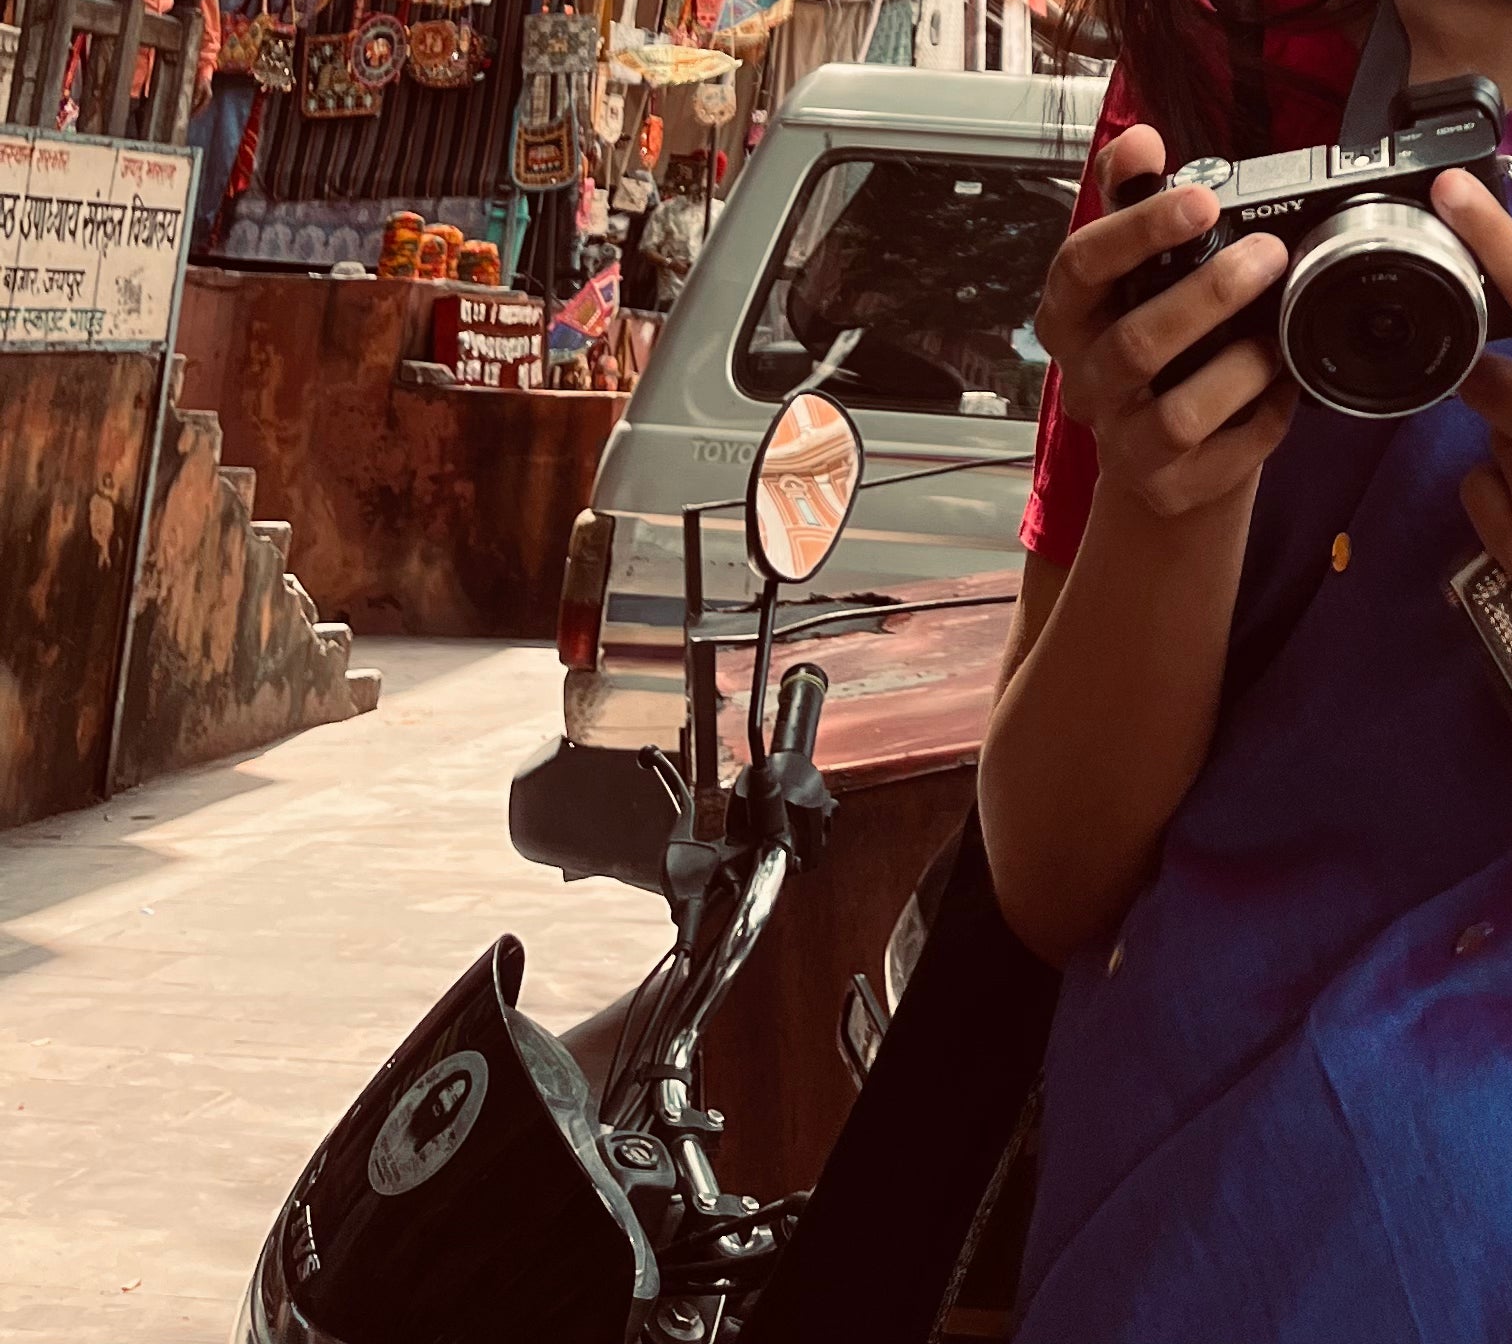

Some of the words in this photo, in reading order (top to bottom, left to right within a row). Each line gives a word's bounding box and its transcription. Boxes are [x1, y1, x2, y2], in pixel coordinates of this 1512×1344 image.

[1241, 198, 1305, 222] SONY
[43, 267, 86, 303] जयपुर
[691, 440, 757, 464] TOYO
